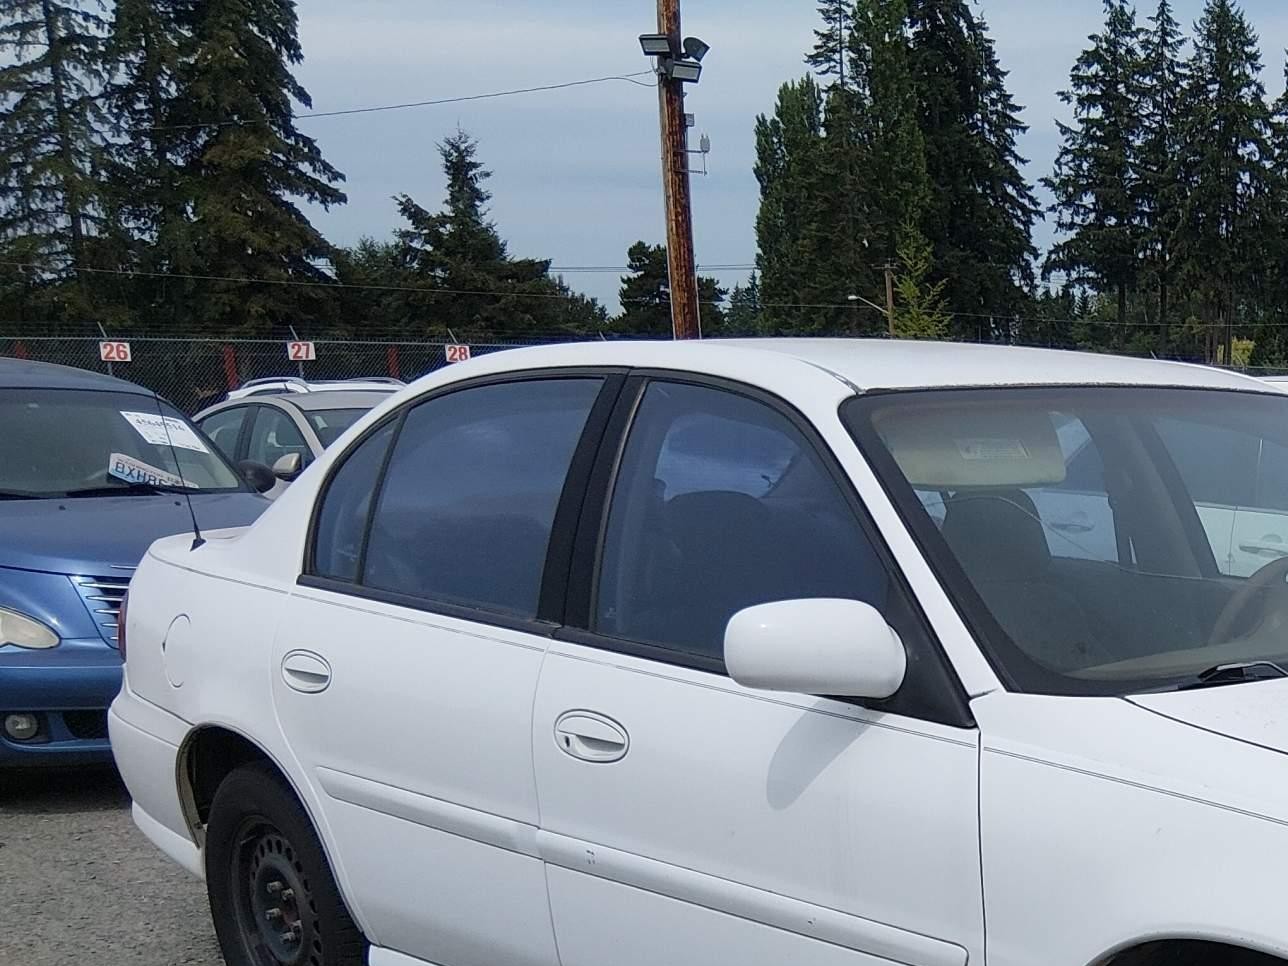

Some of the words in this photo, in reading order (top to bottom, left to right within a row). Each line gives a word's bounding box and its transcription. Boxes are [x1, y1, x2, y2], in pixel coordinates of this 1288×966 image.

[103, 343, 129, 361] 26
[291, 343, 310, 360] 27
[447, 345, 469, 362] 28
